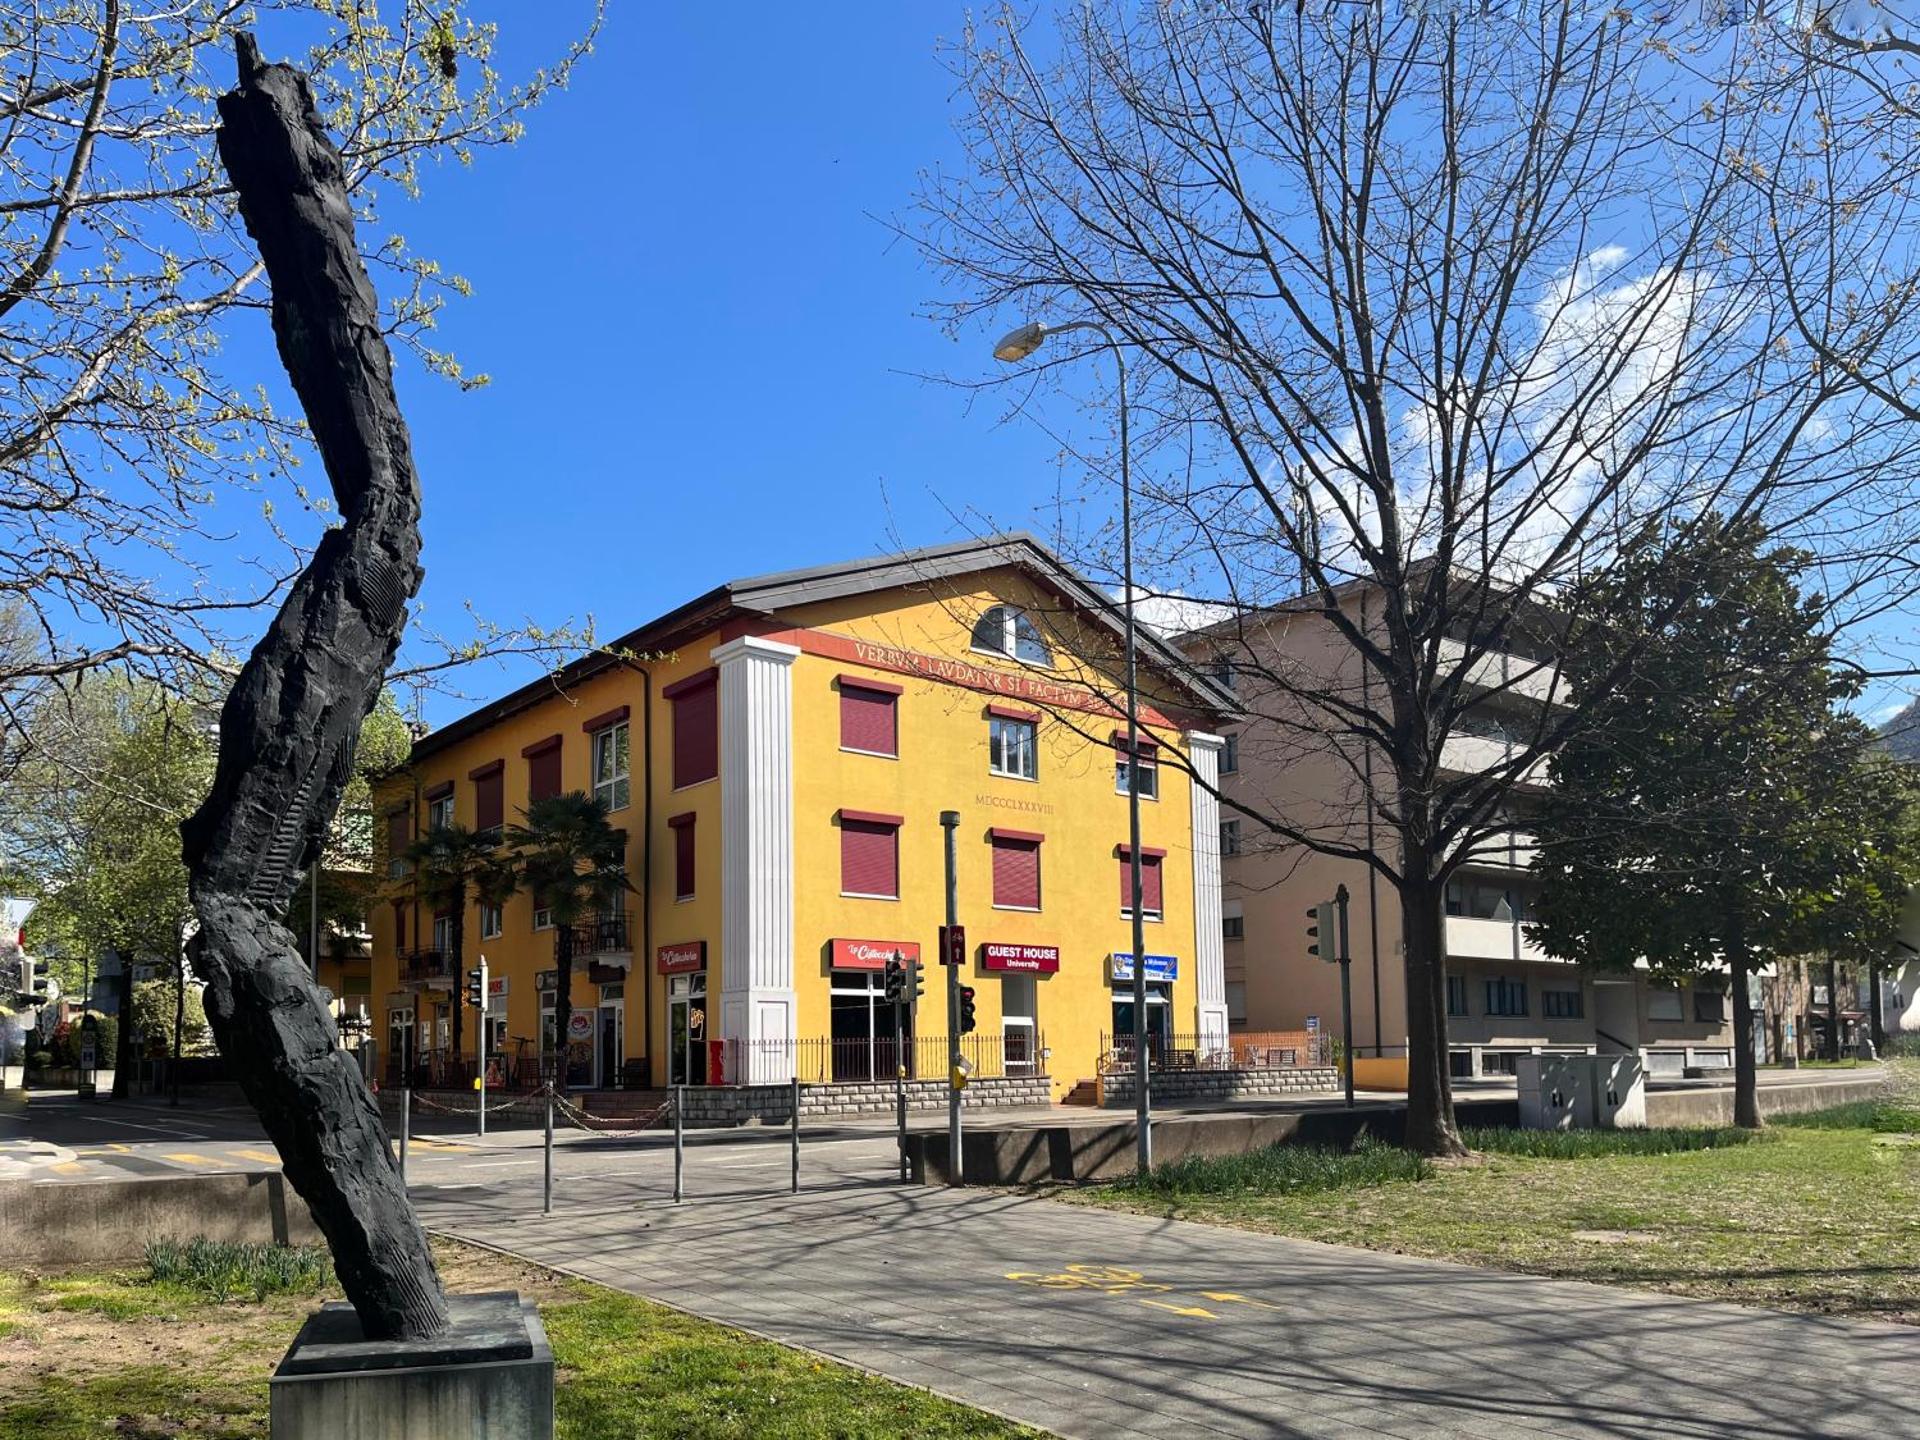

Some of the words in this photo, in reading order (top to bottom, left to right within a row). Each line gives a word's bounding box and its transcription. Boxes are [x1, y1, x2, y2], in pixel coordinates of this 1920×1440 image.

[1007, 677, 1021, 692] SI
[988, 946, 1021, 958] GUEST
[1023, 947, 1057, 960] HOUSE
[1006, 959, 1040, 970] University
